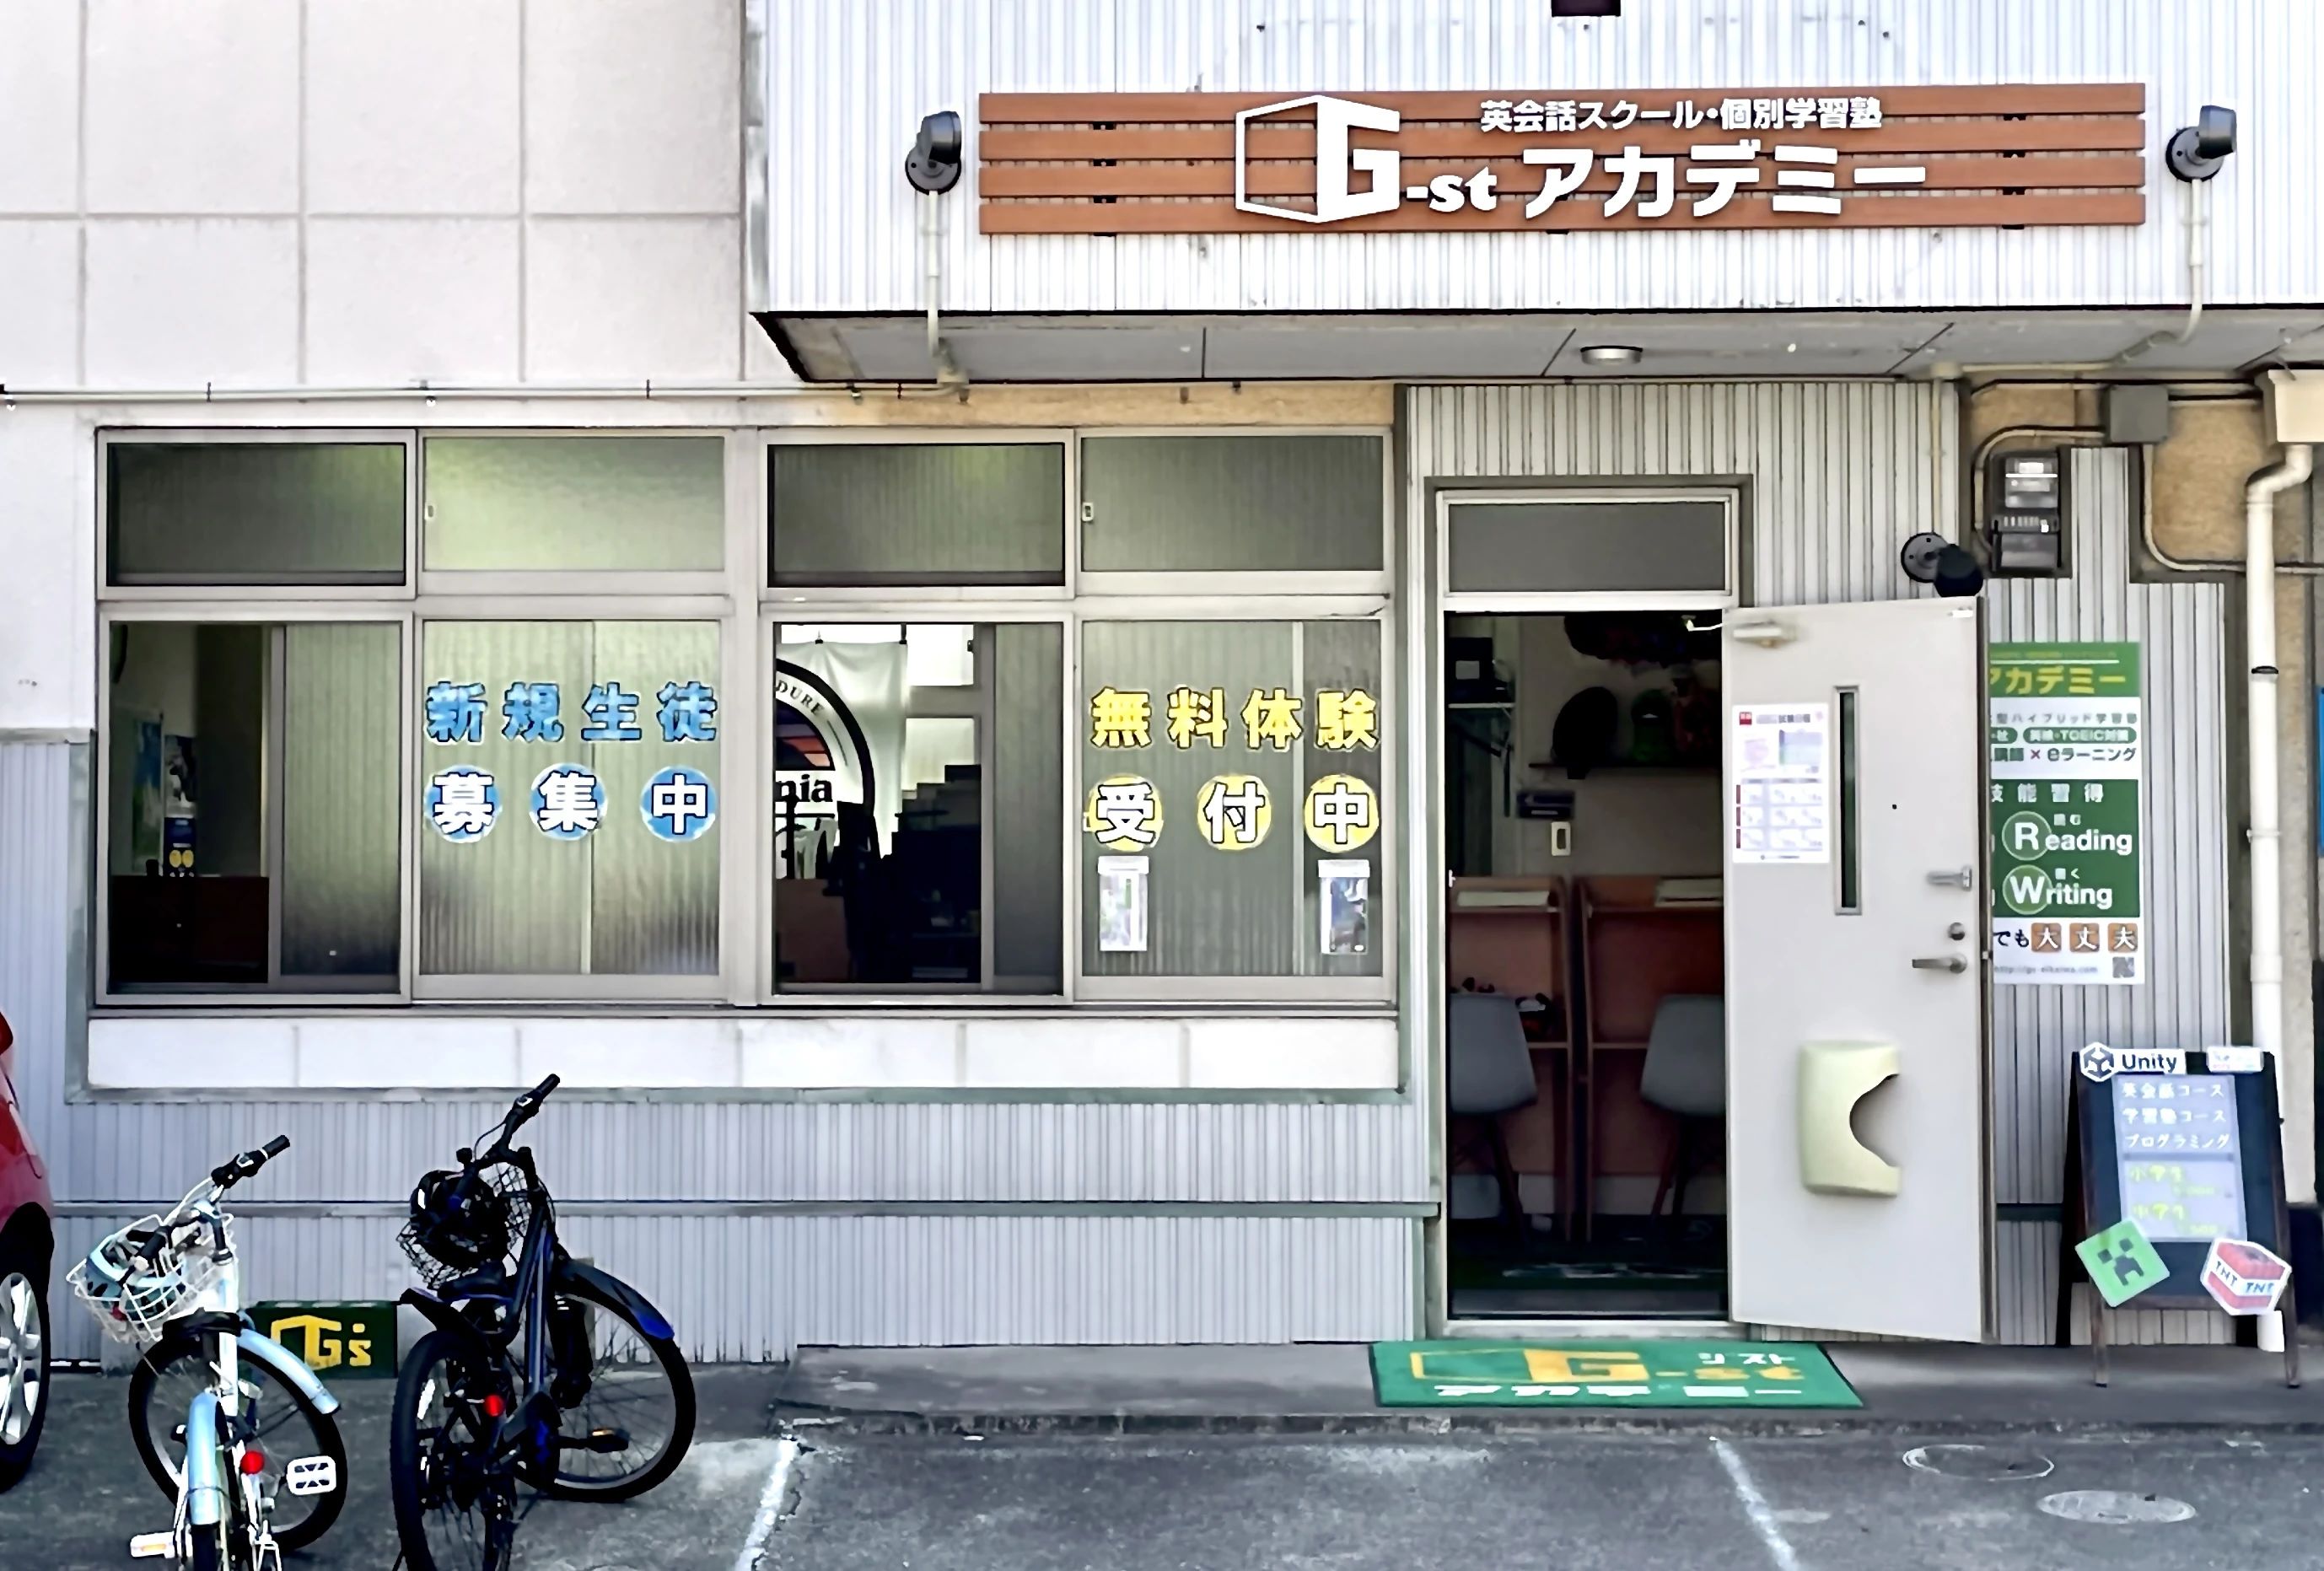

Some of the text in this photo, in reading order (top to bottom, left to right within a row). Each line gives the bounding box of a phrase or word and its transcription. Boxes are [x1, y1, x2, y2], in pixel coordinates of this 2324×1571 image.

[1481, 97, 1882, 132] 英会話スクール・個別学習塾
[1523, 138, 1926, 219] アカデミー
[426, 681, 718, 742] 新規生徒
[1090, 686, 1380, 750] 無料体験
[1993, 747, 2138, 761] ×eラーニング
[431, 770, 708, 835] 募集中
[1095, 781, 1370, 844] 受付中
[2014, 821, 2133, 856] Reading
[2009, 875, 2113, 910] Writing
[2122, 1053, 2177, 1073] Unity
[2214, 1260, 2239, 1288] TNT
